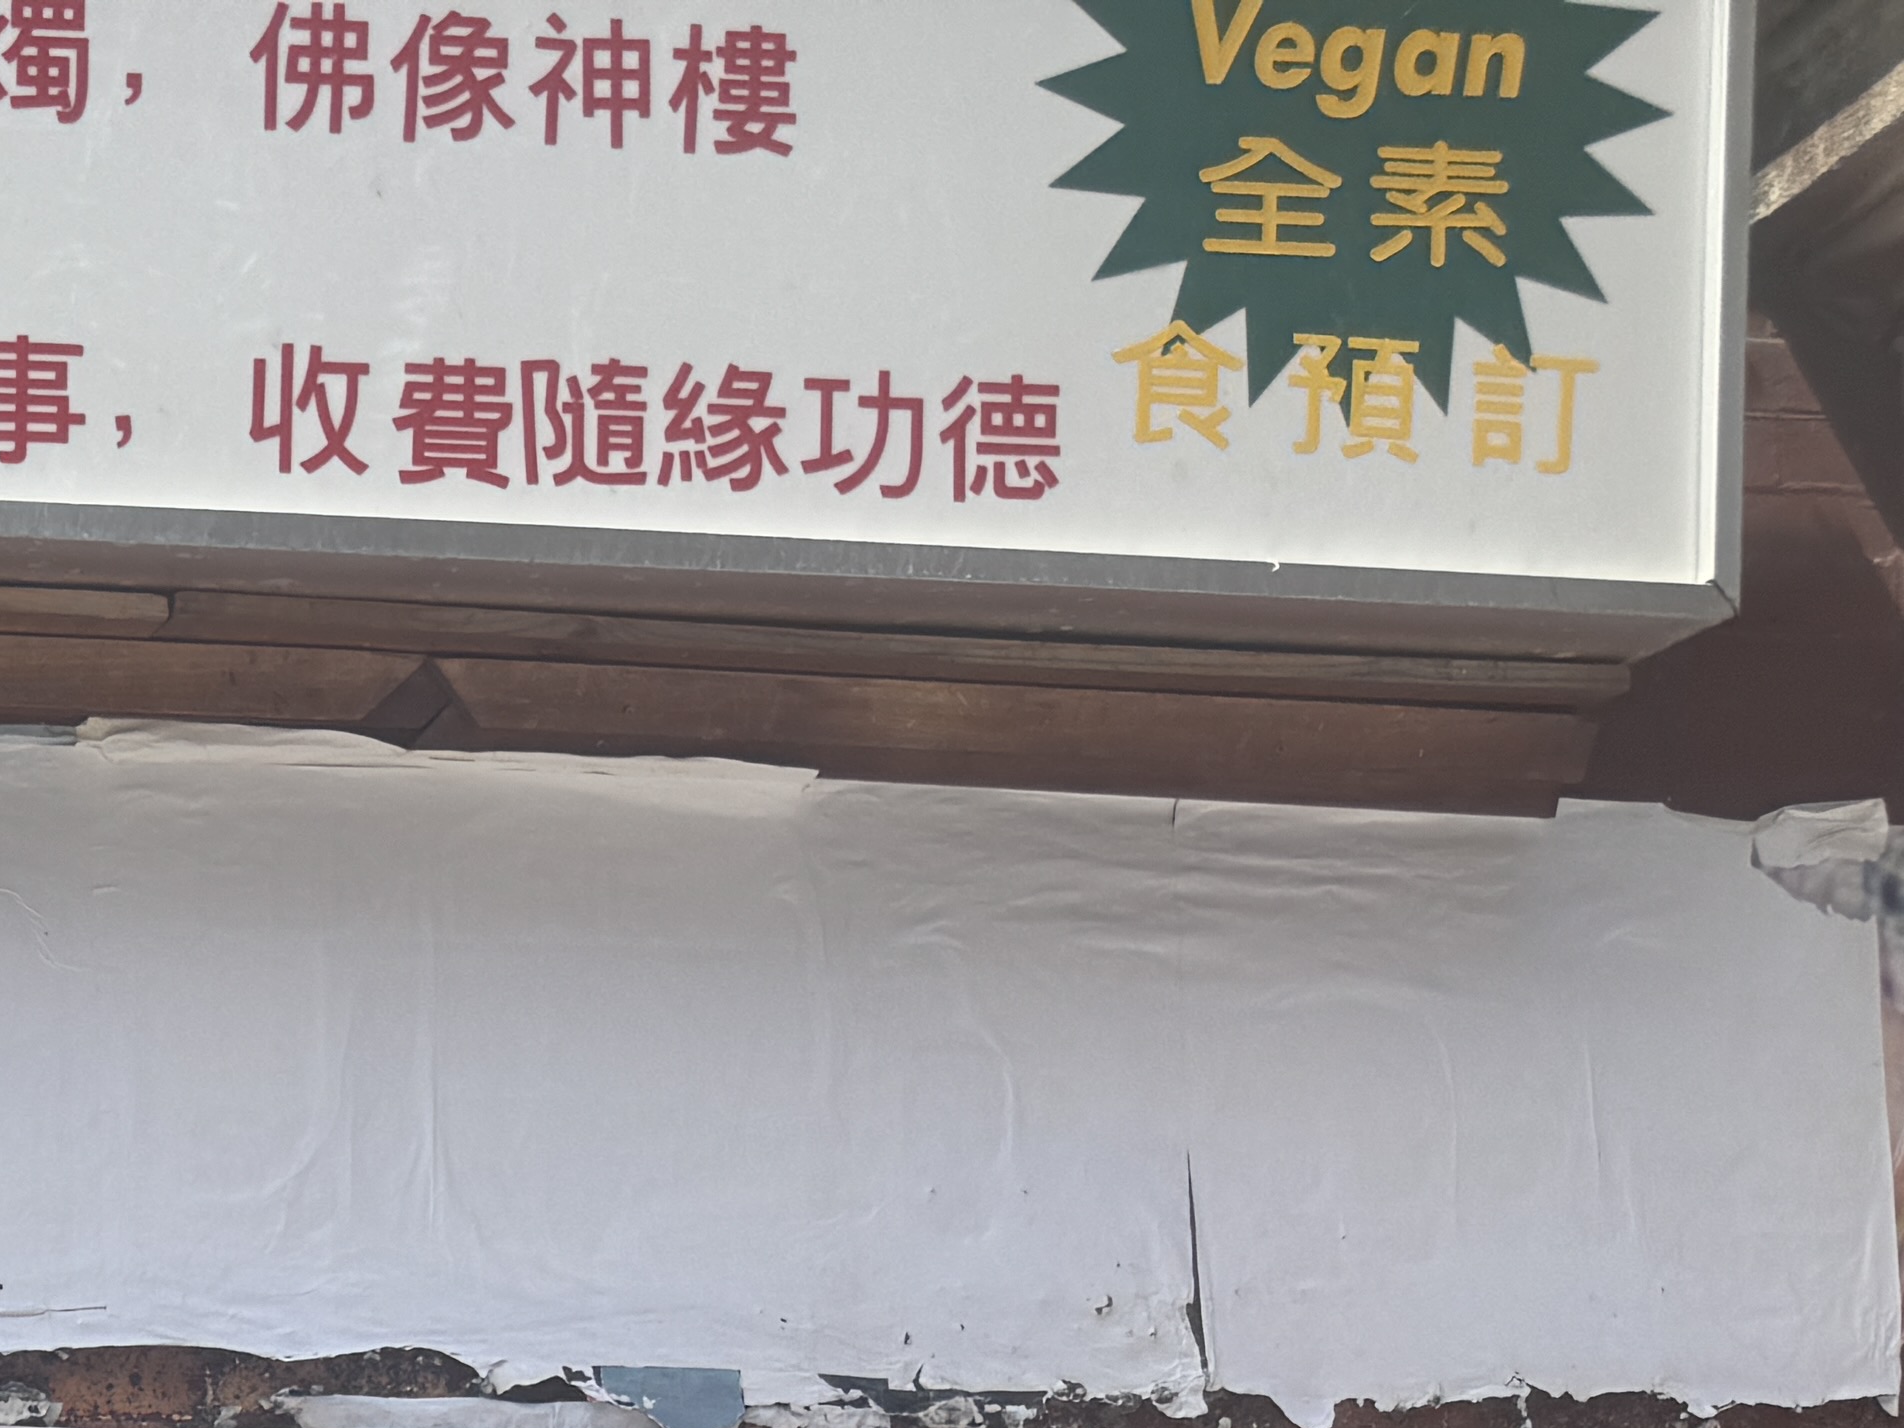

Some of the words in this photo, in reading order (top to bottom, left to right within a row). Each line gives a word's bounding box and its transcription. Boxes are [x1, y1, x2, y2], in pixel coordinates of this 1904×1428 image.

[249, 0, 799, 158] 佛像神樓
[1191, 0, 1525, 118] Vegan
[1198, 137, 1510, 268] 全素
[248, 342, 1060, 501] 收費隨緣功德
[1111, 319, 1599, 474] 食預訂
